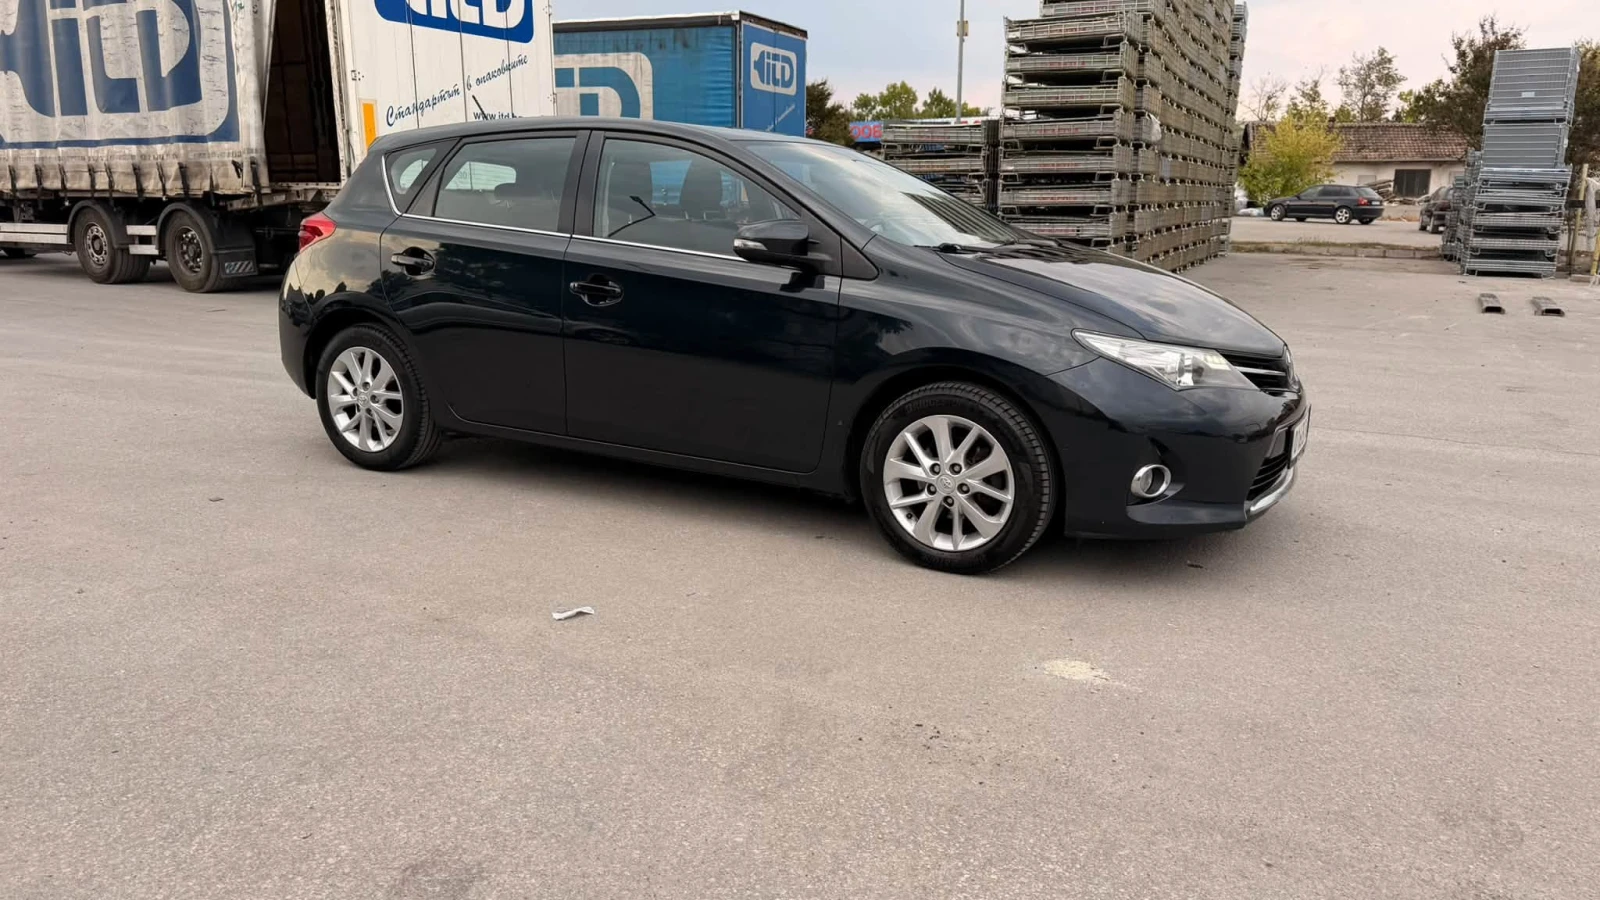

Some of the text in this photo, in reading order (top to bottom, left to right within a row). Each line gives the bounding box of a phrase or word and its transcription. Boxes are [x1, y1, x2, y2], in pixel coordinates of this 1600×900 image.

[385, 83, 461, 127] Стандартът
[475, 53, 529, 86] опаковките
[473, 110, 523, 120] wwwitdb
